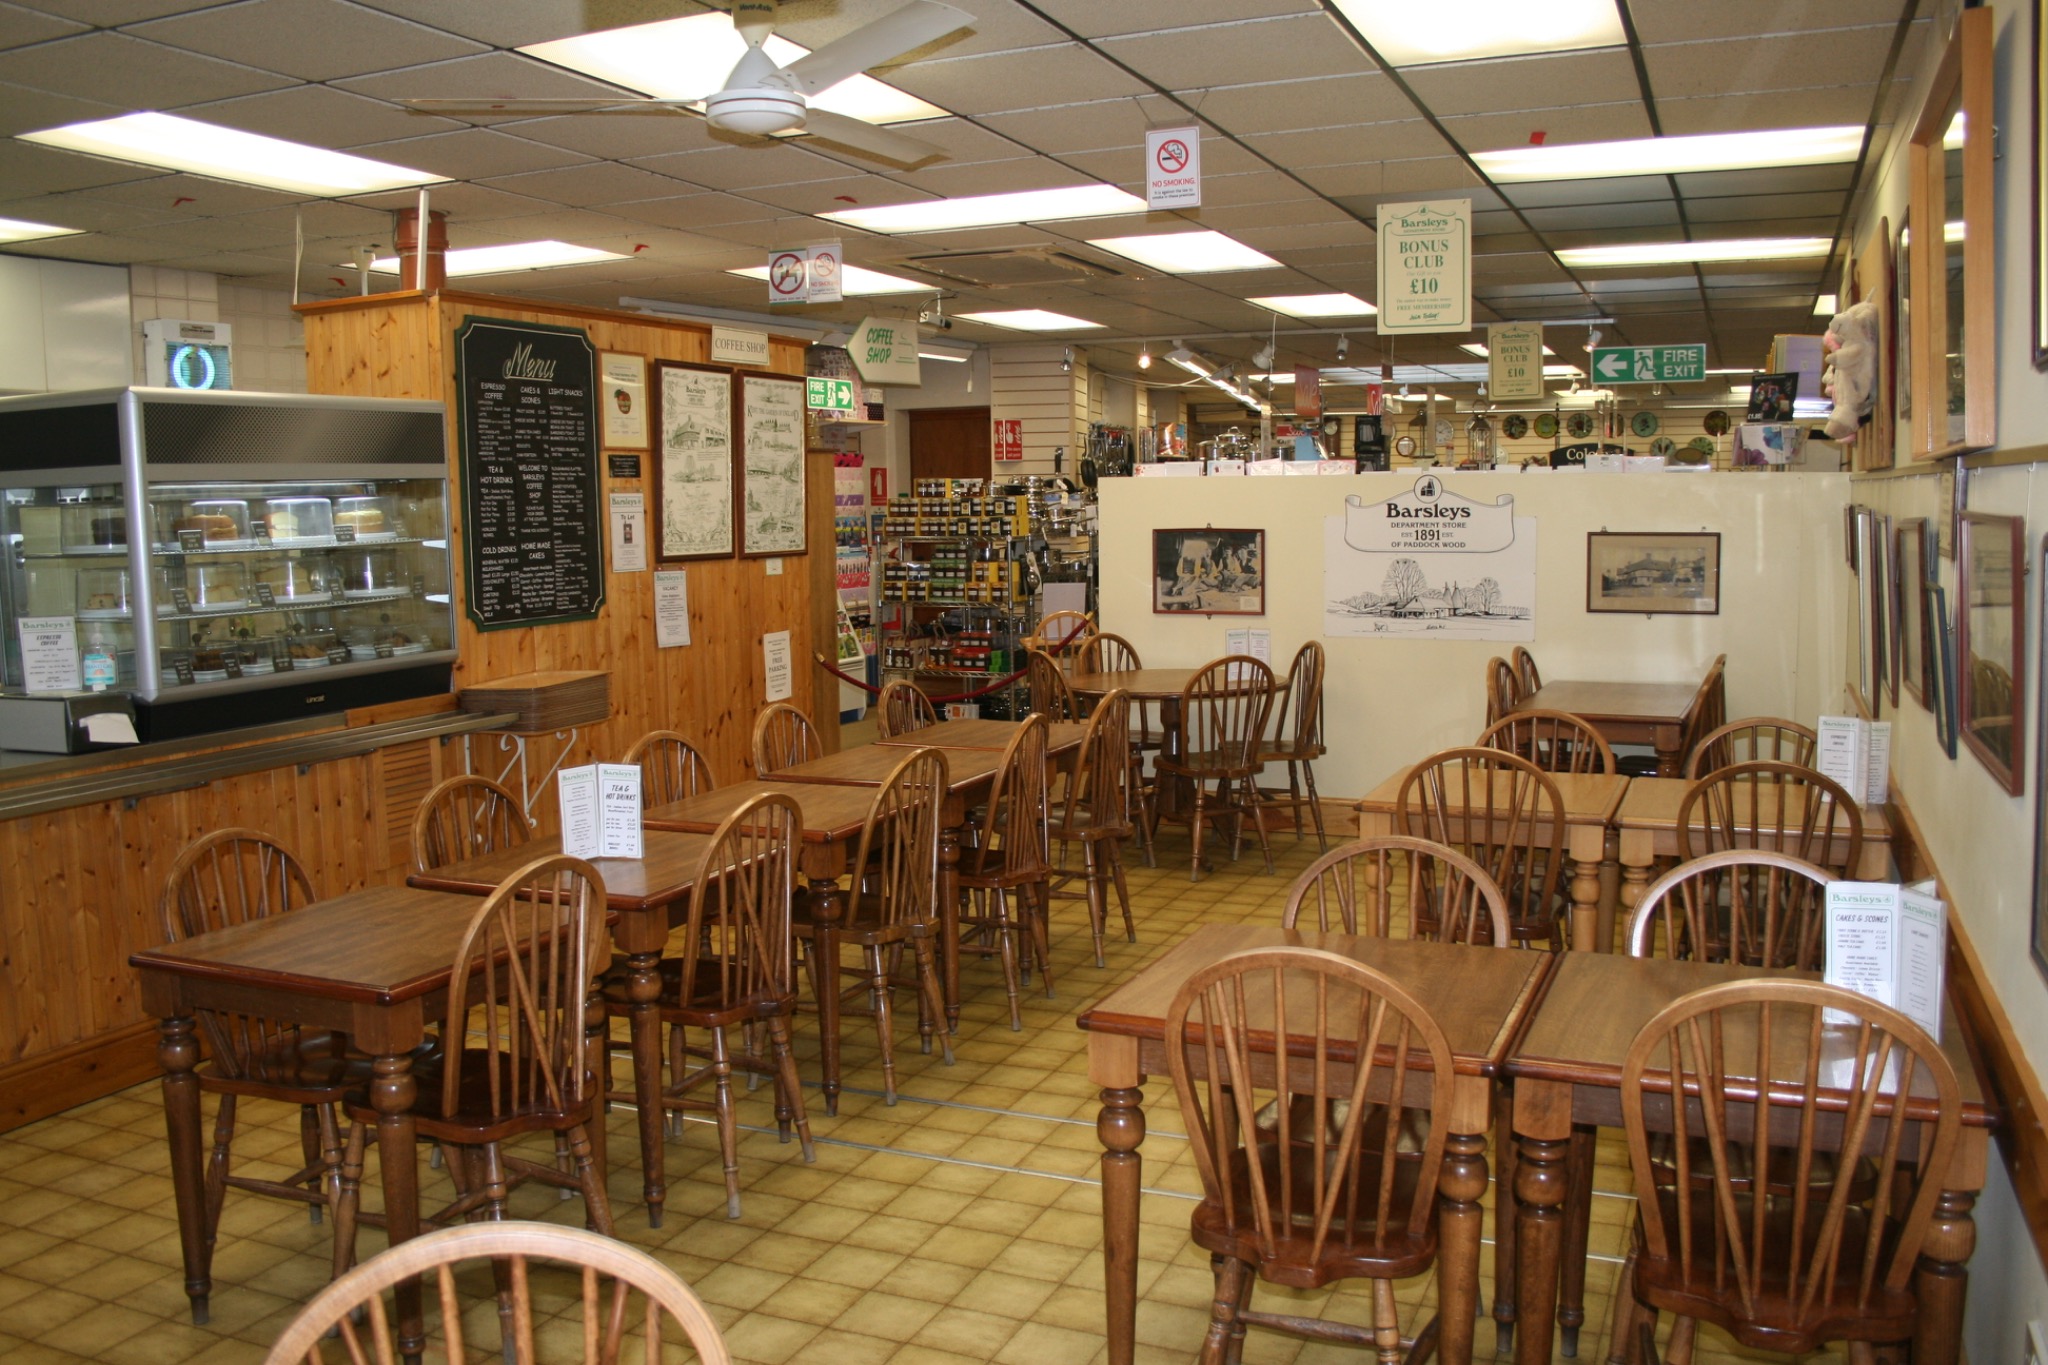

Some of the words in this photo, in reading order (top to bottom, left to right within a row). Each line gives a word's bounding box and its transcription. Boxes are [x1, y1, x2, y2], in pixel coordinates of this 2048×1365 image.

[1401, 218, 1448, 228] Barsleys
[1400, 240, 1448, 254] BONUS
[1404, 255, 1444, 268] CLUB
[1410, 278, 1438, 294] £10
[866, 328, 894, 345] COFFEE
[715, 338, 745, 351] COFFEE
[746, 341, 766, 354] SHOP
[502, 341, 556, 379] Menu
[866, 346, 891, 363] SHOP
[1663, 350, 1697, 362] FIRE
[1508, 368, 1524, 377] £10
[1664, 364, 1697, 377] EXIT
[481, 382, 506, 390] ESPRESSO
[810, 381, 824, 392] FIRE
[810, 393, 825, 405] EXIT
[612, 498, 637, 507] Barsleys
[1386, 503, 1471, 520] Barsleys
[1414, 530, 1440, 540] 1891
[1832, 894, 1882, 904] Barsleys
[1903, 902, 1932, 918] Barsleys
